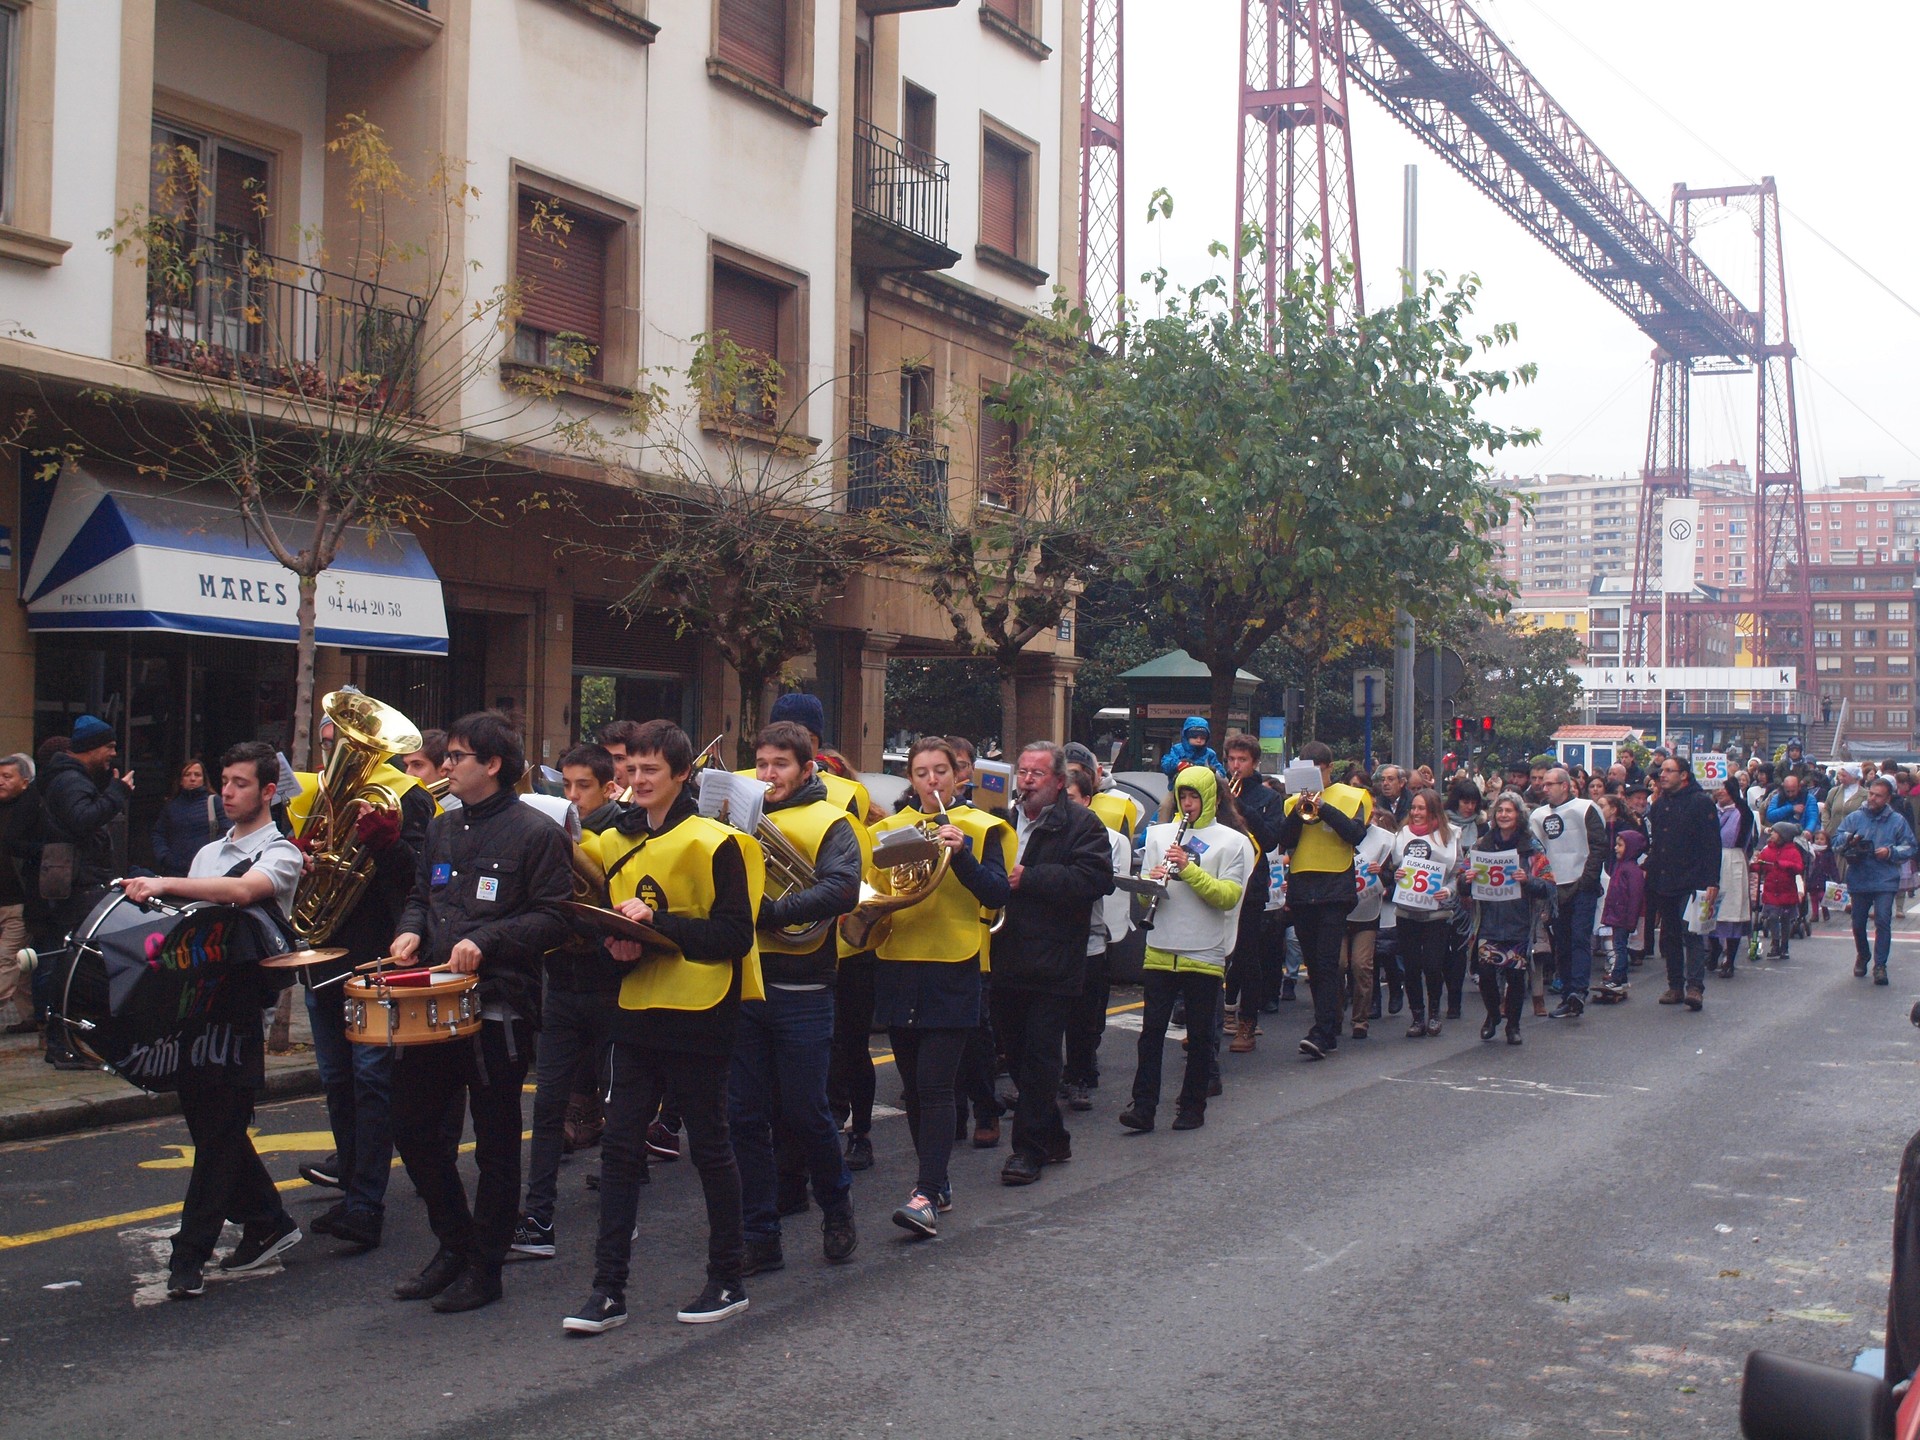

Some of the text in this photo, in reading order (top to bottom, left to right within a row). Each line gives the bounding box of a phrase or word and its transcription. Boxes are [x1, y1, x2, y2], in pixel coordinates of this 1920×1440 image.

[198, 573, 287, 606] MARES
[61, 593, 136, 605] PESCADERIA
[328, 595, 402, 618] 94 464 20 58
[1694, 761, 1727, 779] 365
[1544, 820, 1560, 831] 365
[1408, 846, 1428, 858] 365
[1406, 860, 1441, 873] EUSKARAK
[1476, 856, 1514, 865] EUSKARAK
[1398, 866, 1443, 895] 365
[1473, 863, 1518, 887] 365
[480, 880, 496, 891] 365
[1477, 885, 1514, 897] EGUN
[1398, 890, 1433, 906] EGUN
